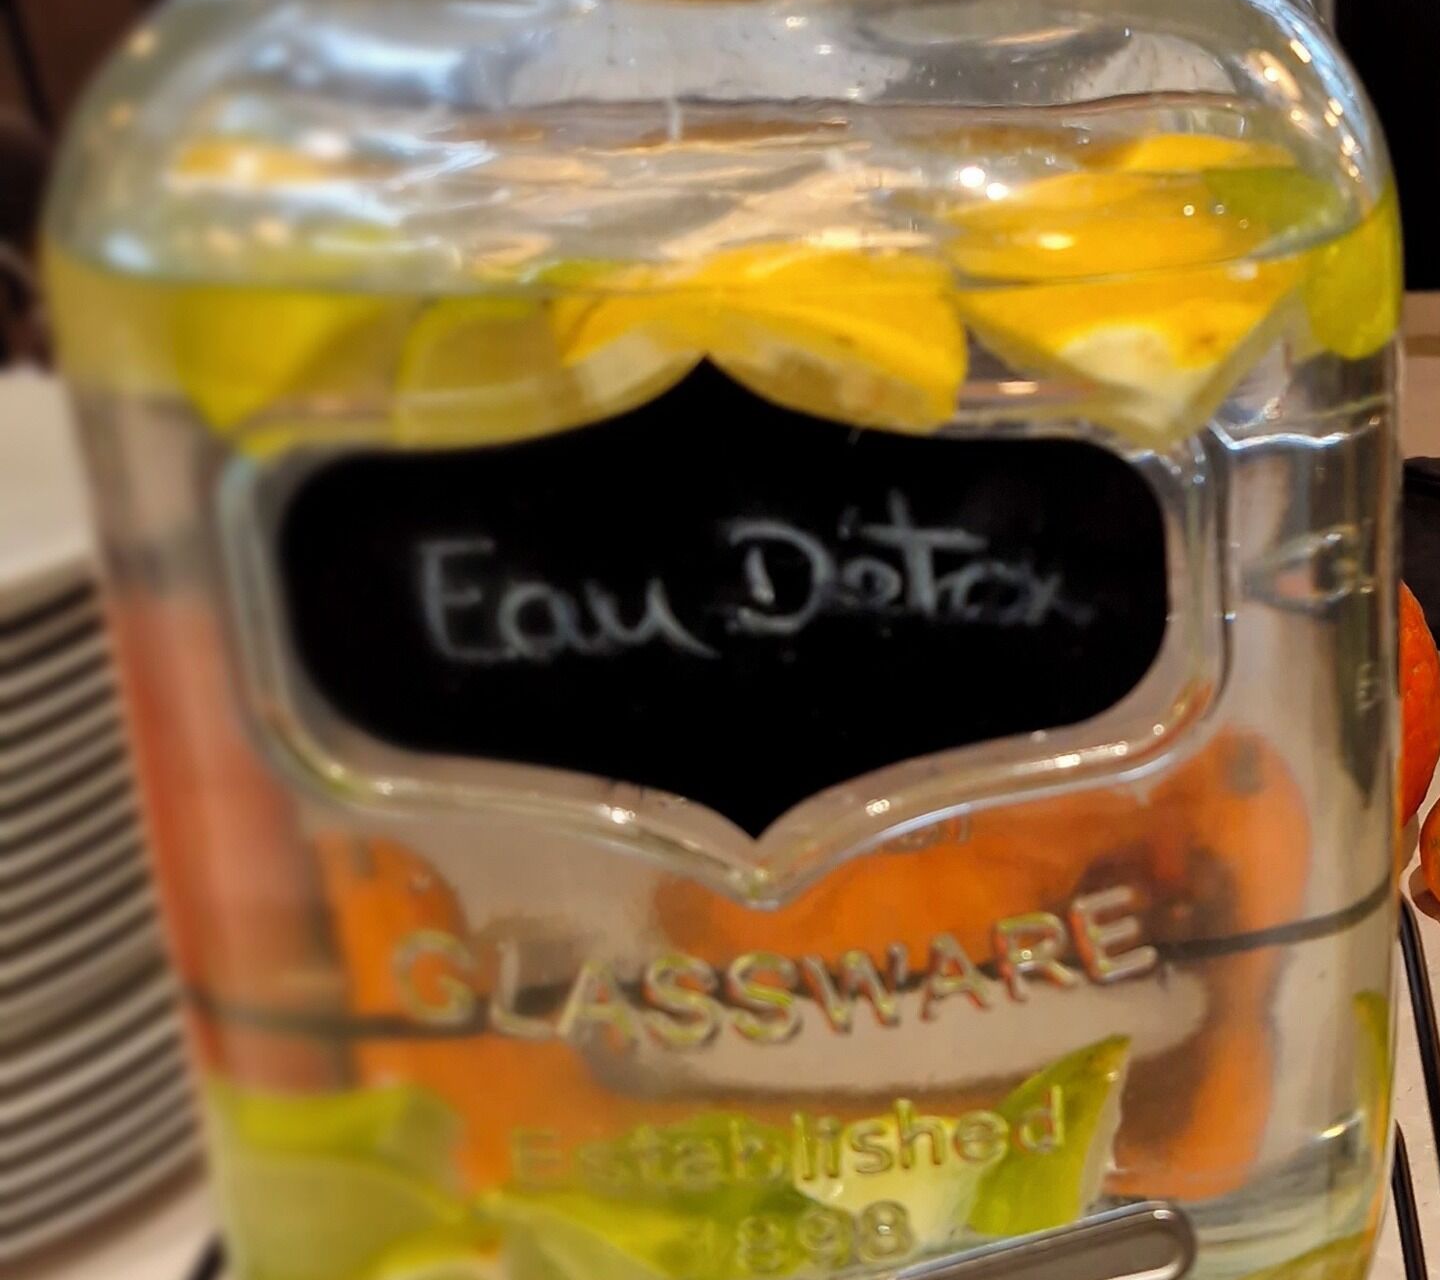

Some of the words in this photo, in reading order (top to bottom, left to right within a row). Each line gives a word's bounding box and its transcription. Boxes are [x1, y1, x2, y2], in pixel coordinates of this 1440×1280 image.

[415, 535, 722, 661] Eau
[392, 884, 1159, 1052] GLASSWARE
[511, 1084, 1064, 1196] Established
[700, 1199, 913, 1276] 1898
